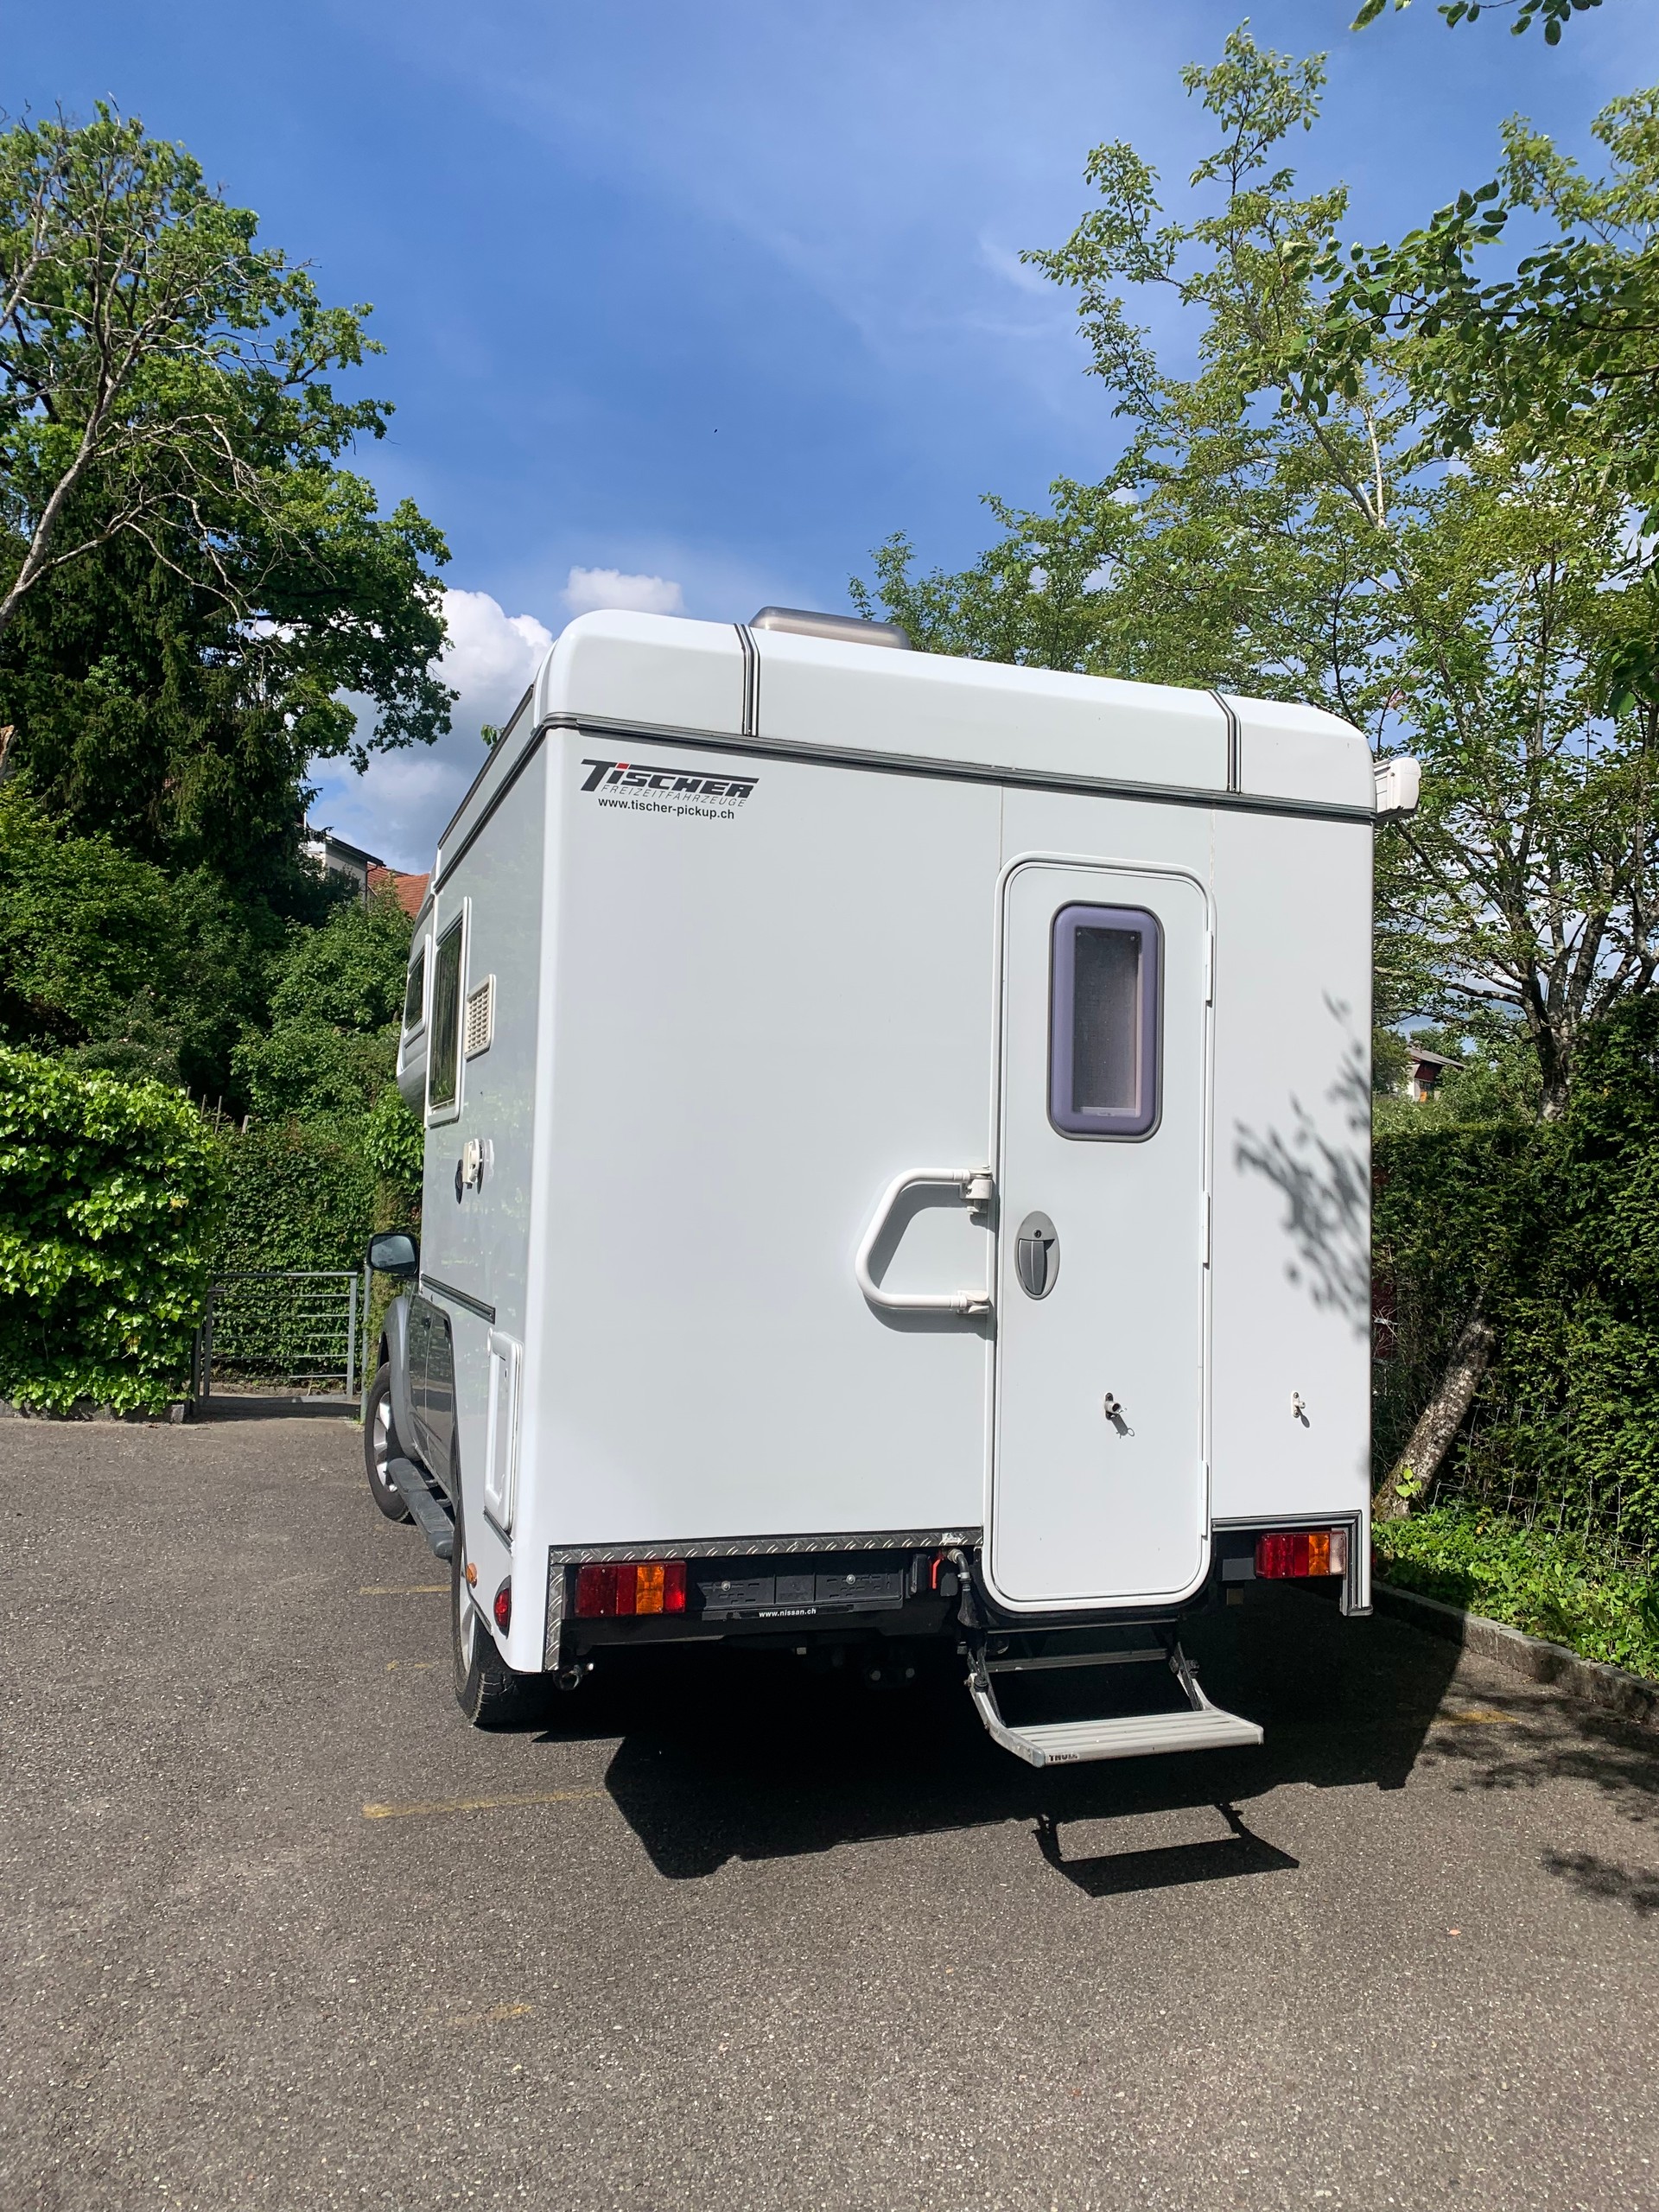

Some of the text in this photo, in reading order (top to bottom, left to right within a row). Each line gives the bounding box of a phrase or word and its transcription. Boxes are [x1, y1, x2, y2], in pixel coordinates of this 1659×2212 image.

[601, 785, 747, 807] FREIZEITFAHRZEUGE
[598, 798, 734, 819] www.tischer-pickup.ch
[759, 1608, 817, 1618] www.nissan.ch
